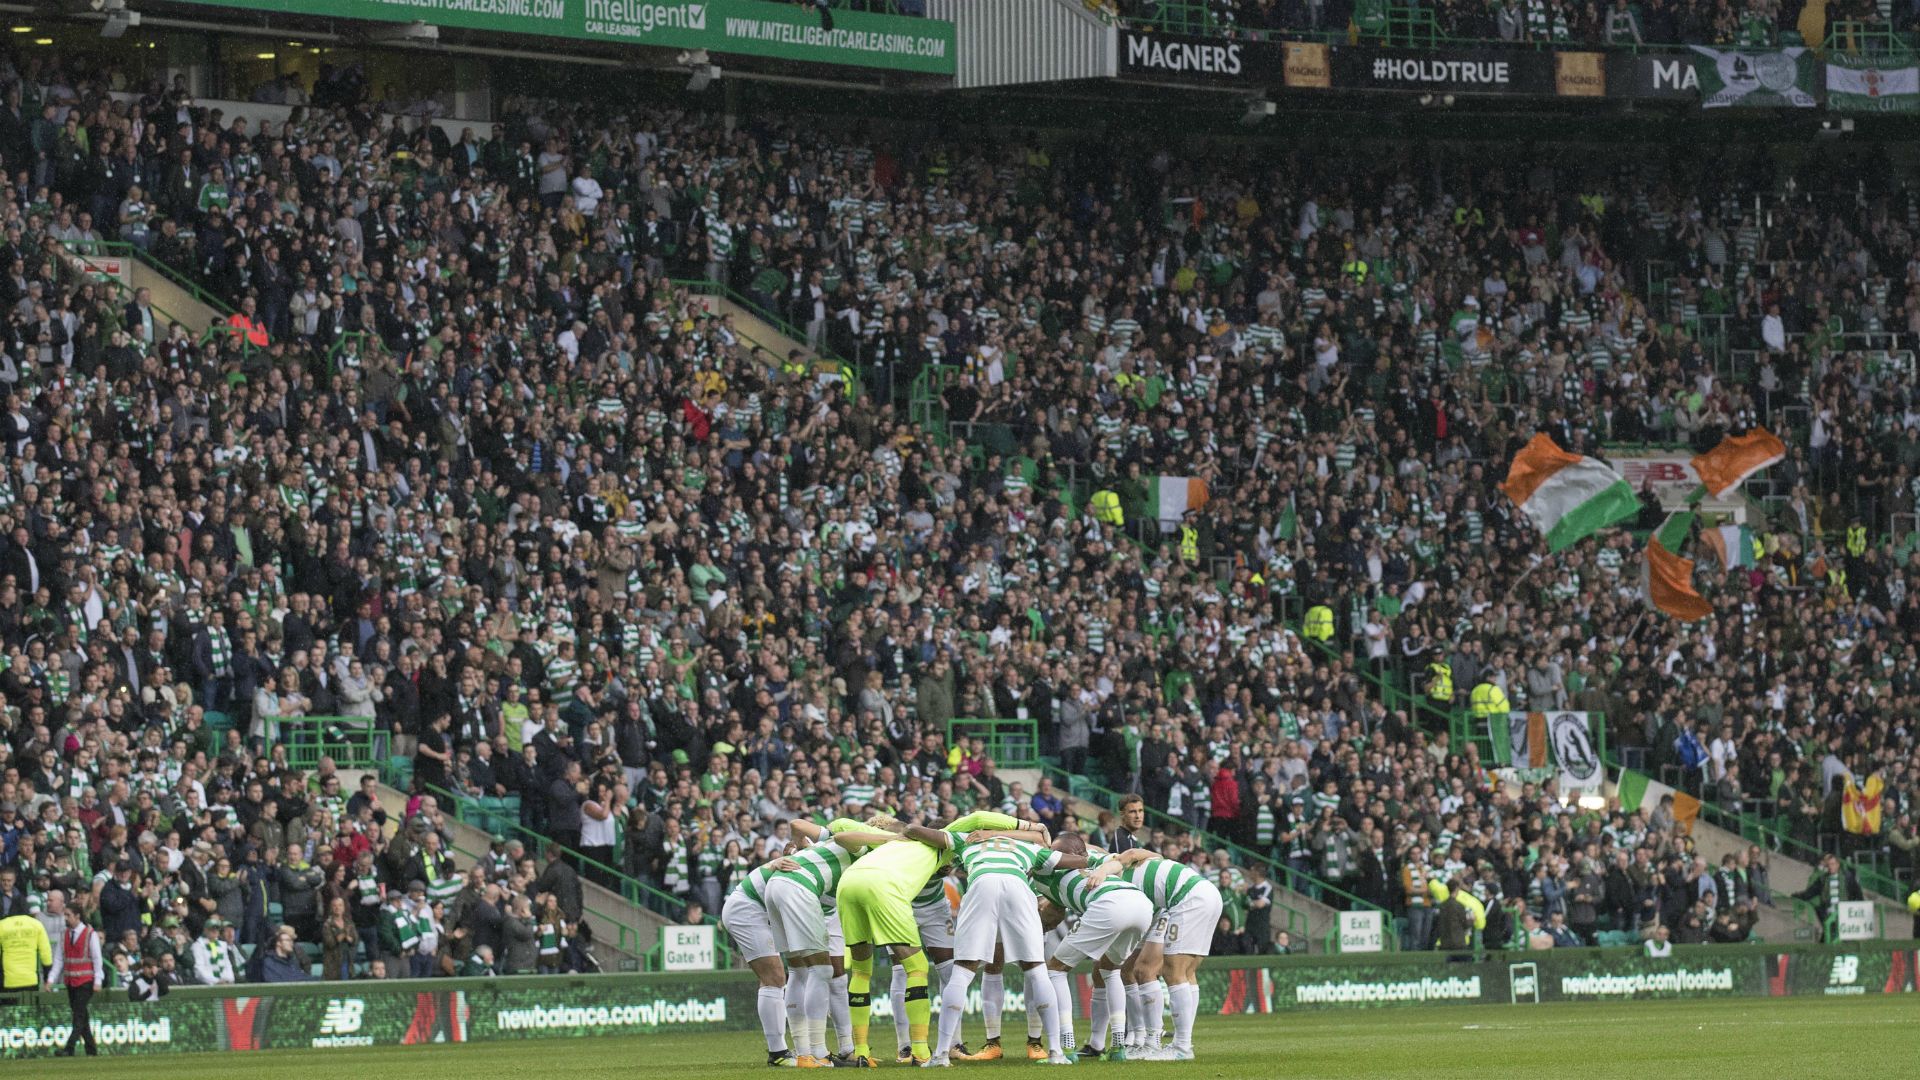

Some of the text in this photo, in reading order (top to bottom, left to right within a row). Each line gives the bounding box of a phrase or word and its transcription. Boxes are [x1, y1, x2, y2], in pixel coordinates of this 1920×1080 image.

[585, 20, 641, 37] CAR LEASING
[725, 17, 945, 58] WWW.INTELLIGENTCARLEASING.COM
[1127, 34, 1242, 75] MAGNERS
[1372, 57, 1510, 84] #HOLDTRUE
[1849, 907, 1865, 919] Exit
[1168, 923, 1179, 942] 9
[1350, 918, 1371, 930] Exit
[1839, 922, 1875, 934] Gate 14
[677, 932, 701, 946] Exit
[1342, 934, 1381, 946] Gate 12
[667, 950, 712, 964] Gate 11
[1296, 976, 1481, 1003] newbalance.com/football
[1562, 968, 1733, 994] newbalance.com/football
[498, 997, 726, 1030] newbalance.com/football
[0, 1016, 171, 1049] nce.cofootball
